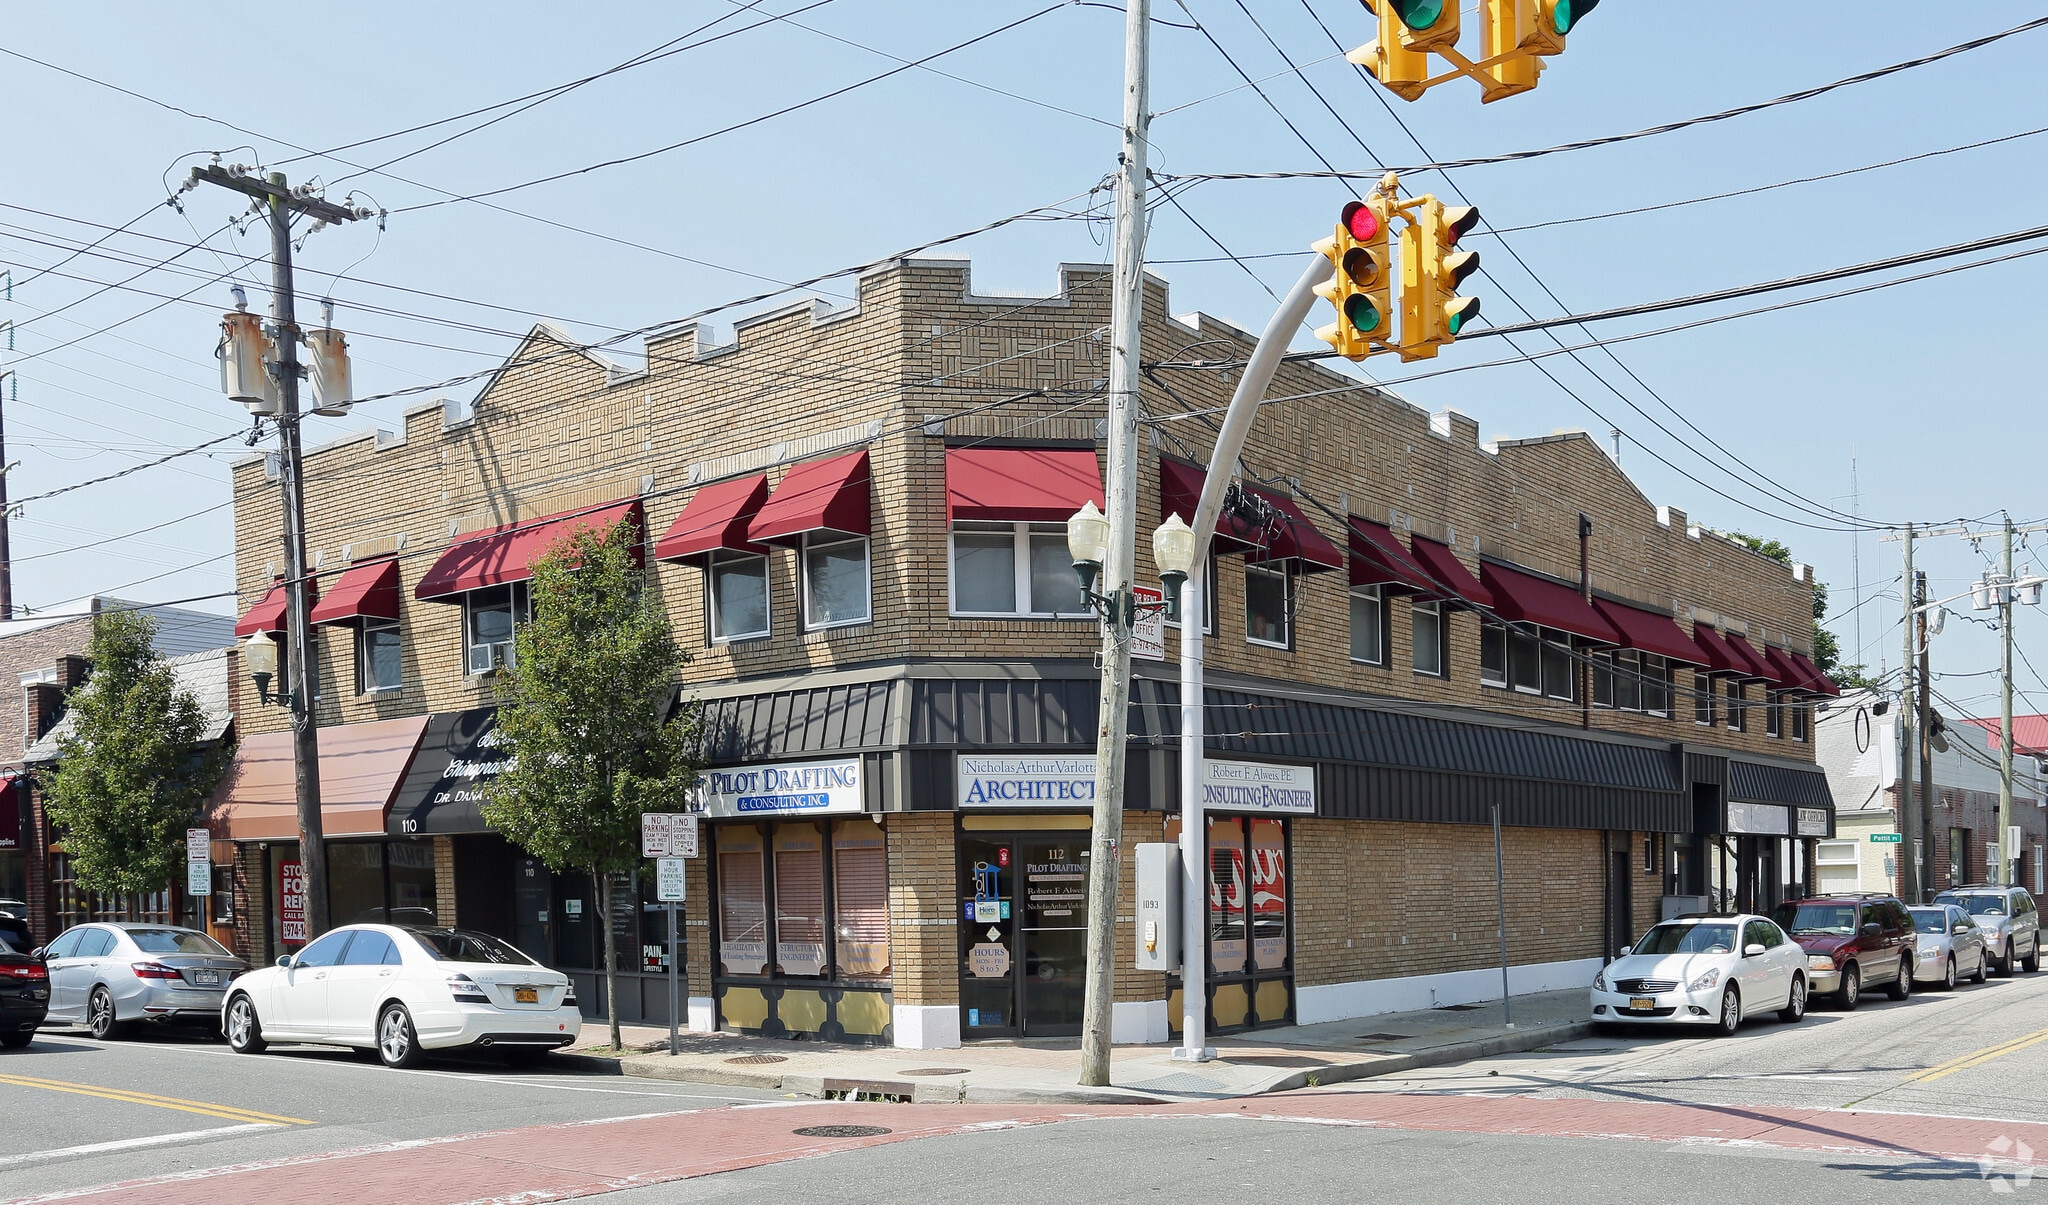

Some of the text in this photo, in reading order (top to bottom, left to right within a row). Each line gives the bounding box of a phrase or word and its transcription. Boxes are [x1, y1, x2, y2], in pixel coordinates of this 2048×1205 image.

[1136, 623, 1154, 636] OFFICE
[965, 760, 1015, 773] Nicholas
[1015, 760, 1055, 773] Arthur
[1213, 764, 1241, 779] Robert
[1253, 768, 1280, 782] Alweis,
[1281, 769, 1293, 781] PE
[711, 765, 857, 795] PILOT DRAFTING
[434, 792, 451, 804] DR.
[1203, 784, 1313, 808] ONSULTING ENGINEER
[740, 799, 748, 809] &
[750, 796, 806, 809] CONSULTING
[402, 819, 417, 833] 110
[651, 816, 662, 824] NO
[678, 818, 689, 827] NO
[1048, 849, 1064, 860] 112
[283, 865, 302, 877] STO
[525, 869, 535, 877] 110
[1027, 863, 1088, 873] PILOT DRAFTING
[283, 878, 303, 894] FO
[1027, 887, 1052, 895] Robert
[1142, 900, 1159, 909] 1093
[643, 945, 662, 957] PAIN
[974, 949, 1005, 957] HOURS
[980, 964, 985, 972] 8
[995, 964, 1000, 972] 5
